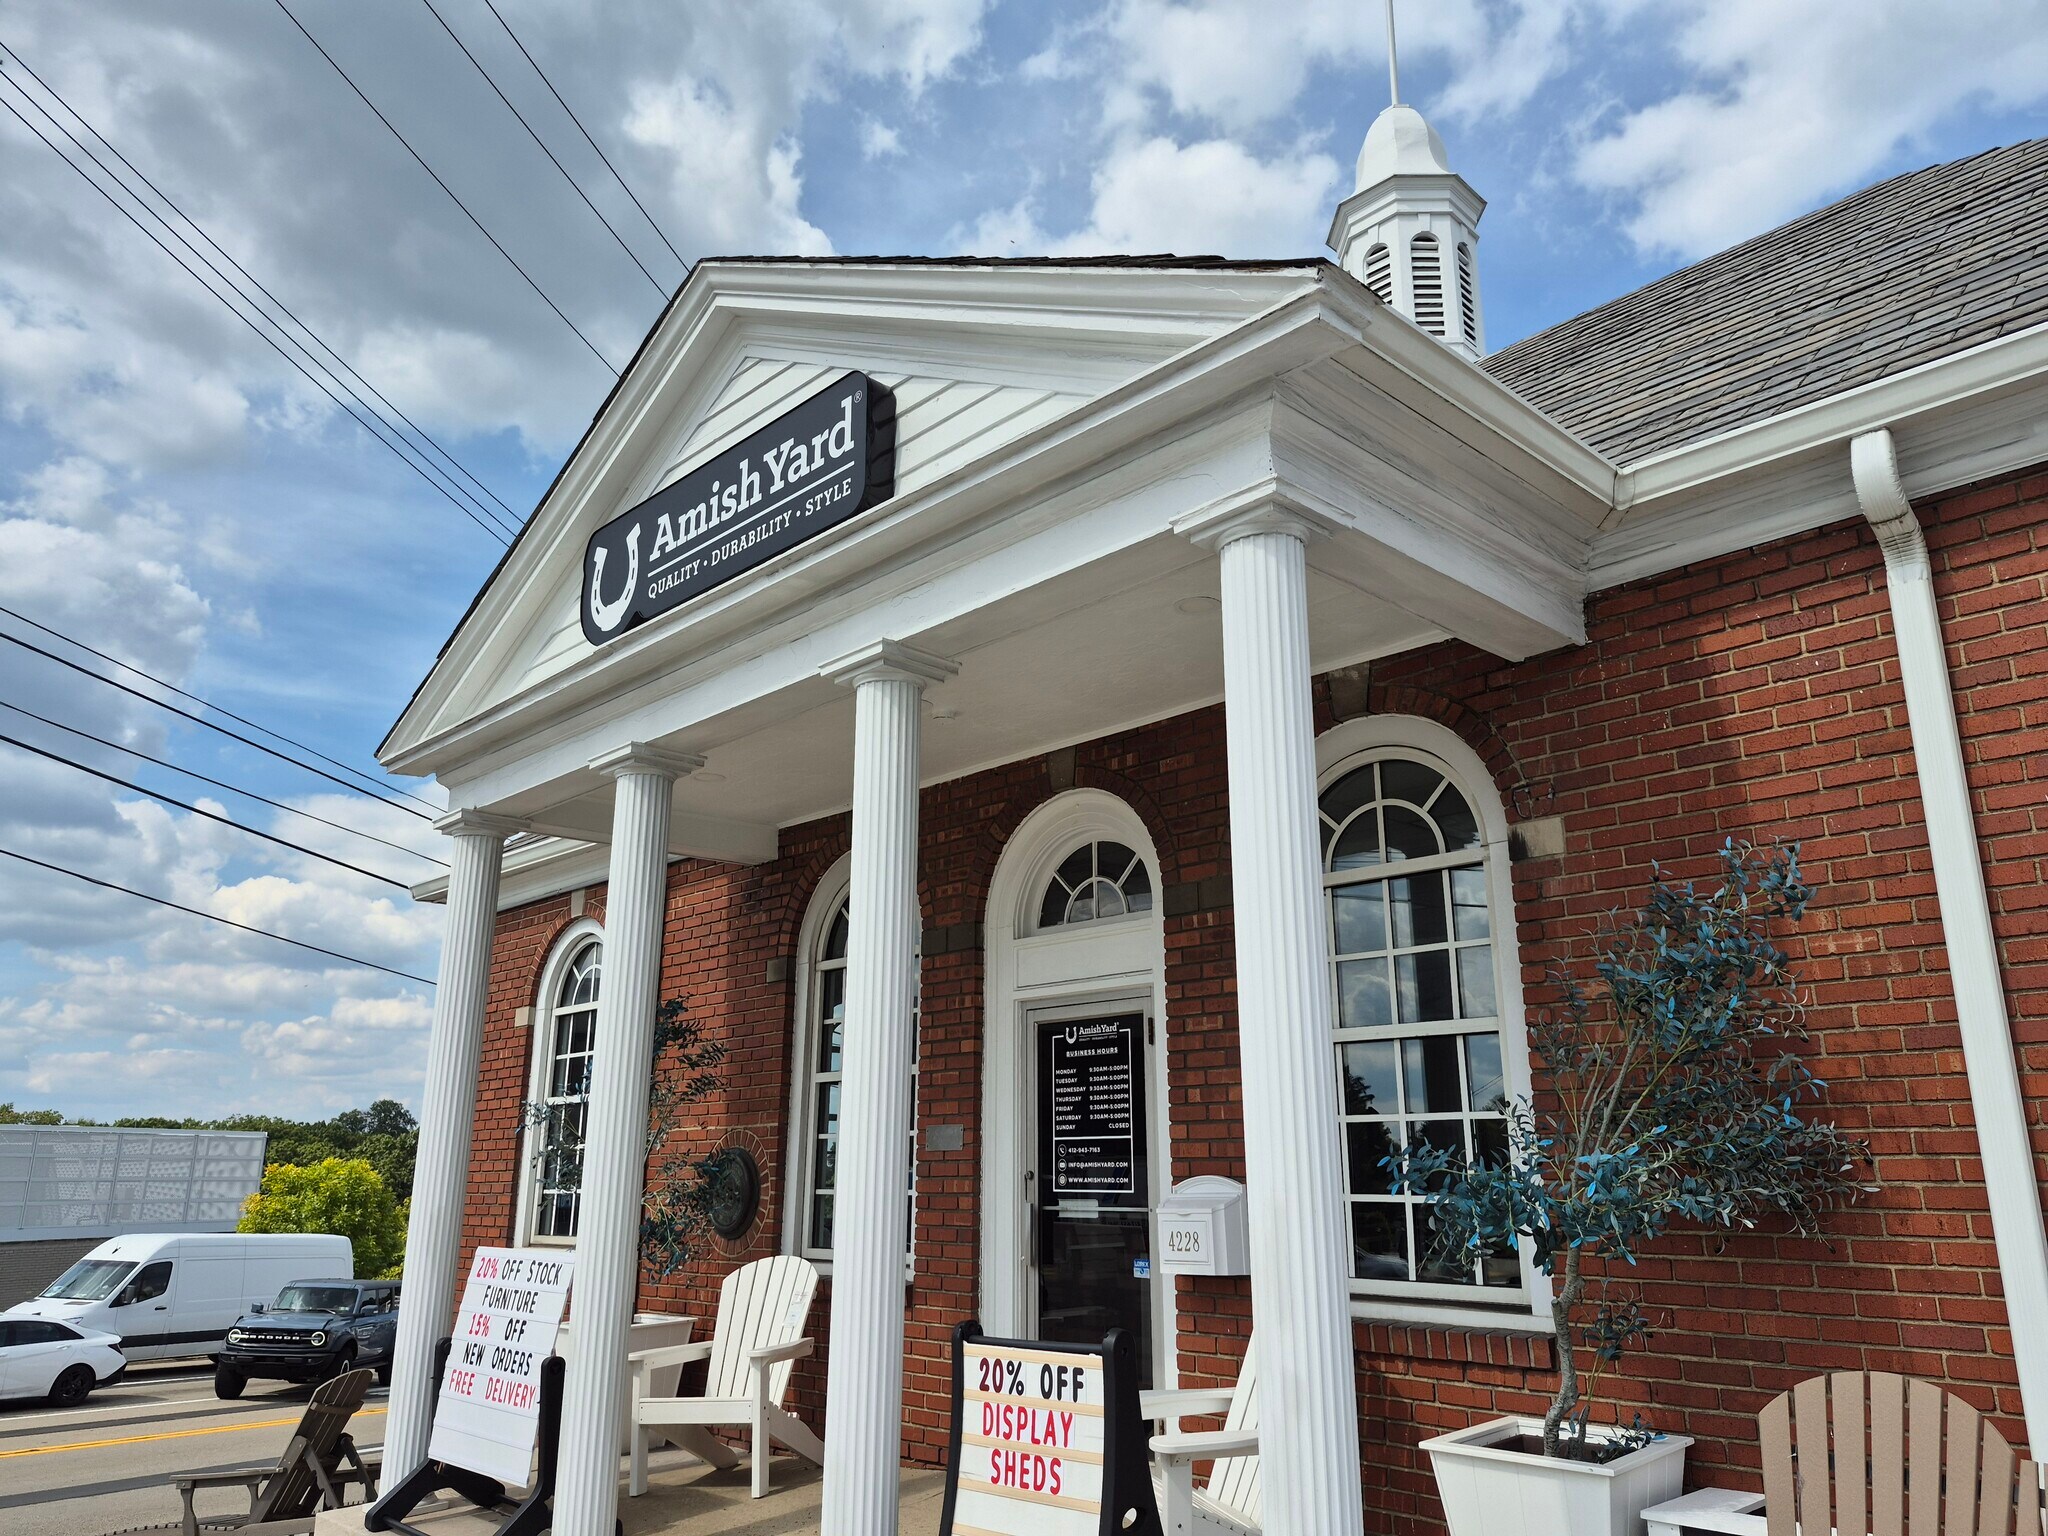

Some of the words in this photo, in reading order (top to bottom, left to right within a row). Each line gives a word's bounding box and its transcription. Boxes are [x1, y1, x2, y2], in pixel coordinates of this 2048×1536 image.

[649, 458, 762, 562] Amish
[648, 559, 700, 599] QUALITY
[711, 510, 793, 567] DURABILITY
[805, 477, 851, 516] STYLE
[1066, 1049, 1095, 1057] BUSINESS
[1097, 1047, 1118, 1055] HOURS
[1068, 1161, 1128, 1169] INFO@AMISHYARD.COM
[1168, 1231, 1200, 1252] 4228
[476, 1257, 499, 1279] 20%
[502, 1259, 523, 1282] OFF
[526, 1260, 563, 1286] STOCK
[482, 1285, 539, 1314] FURNITURE
[469, 1313, 491, 1337] 15%
[504, 1317, 527, 1343] OFF
[463, 1342, 486, 1366] NEW
[491, 1346, 533, 1376] ORDERS
[449, 1369, 476, 1396] FREE
[485, 1376, 537, 1410] DELIVERY
[979, 1357, 1025, 1396] 20%
[1040, 1363, 1084, 1403] OFF
[982, 1401, 1073, 1448] DISPLAY
[990, 1448, 1062, 1495] SHEDS
